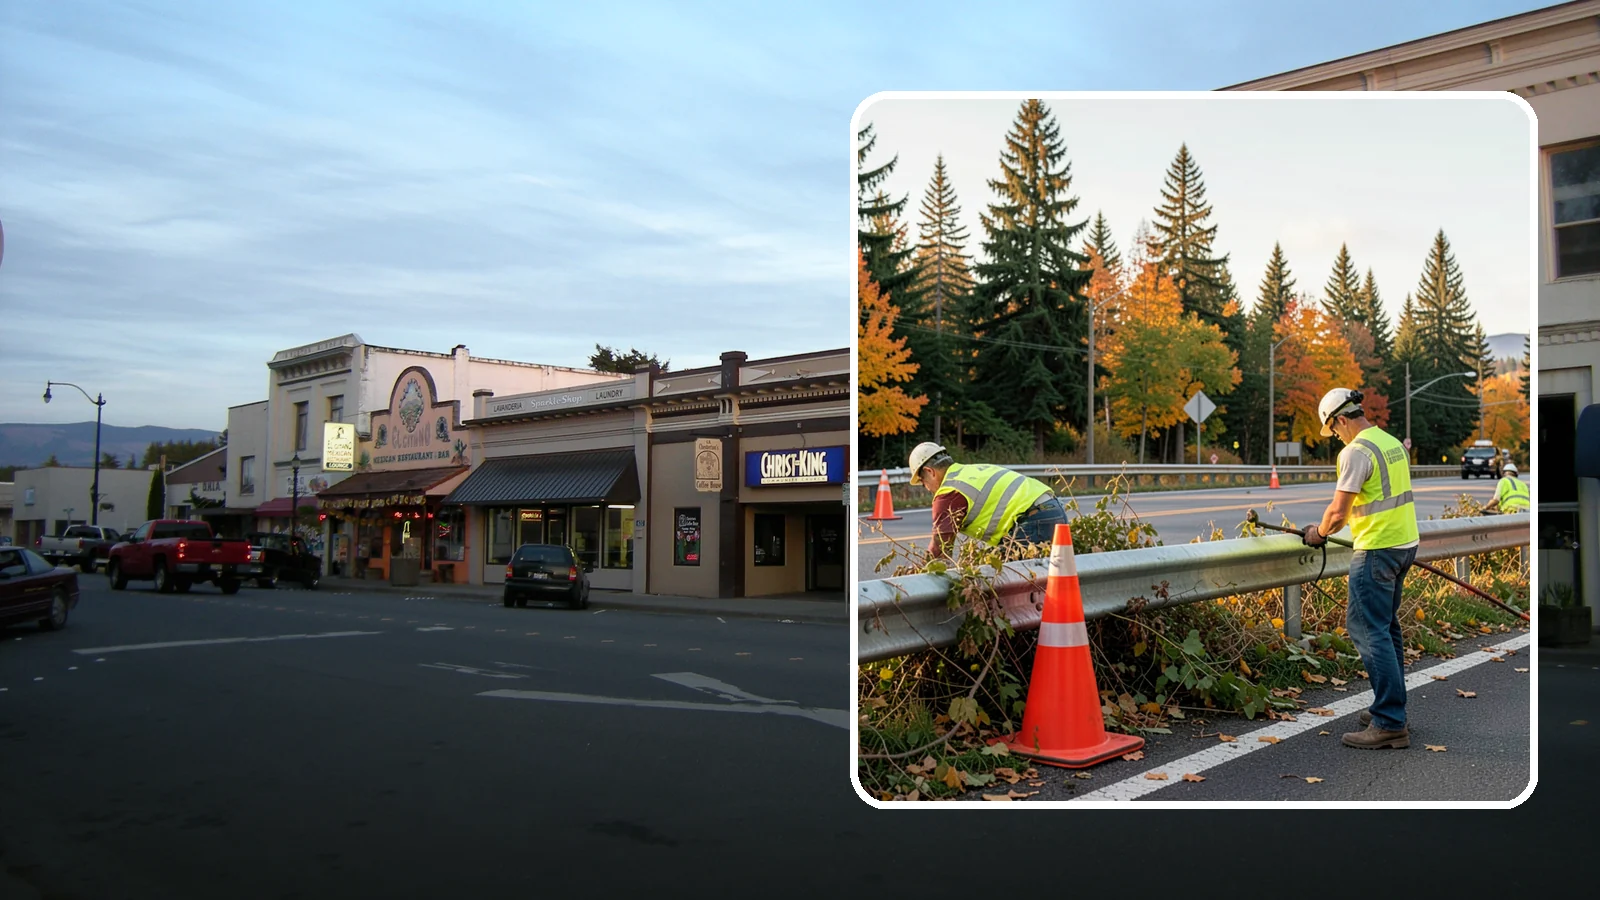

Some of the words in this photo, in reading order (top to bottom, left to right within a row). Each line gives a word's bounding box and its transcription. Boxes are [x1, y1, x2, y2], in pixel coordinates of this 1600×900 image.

[596, 389, 623, 400] LAUNDRY
[493, 402, 522, 412] LAVANDERIA
[531, 397, 561, 409] Sparkle
[562, 394, 582, 405] Shop
[374, 454, 396, 464] MEXICAN
[398, 451, 433, 462] RESTAURANT
[438, 450, 450, 459] BAR
[761, 452, 797, 478] CHRIST
[799, 450, 827, 476] KING
[696, 480, 709, 489] Coffee
[710, 480, 722, 489] House
